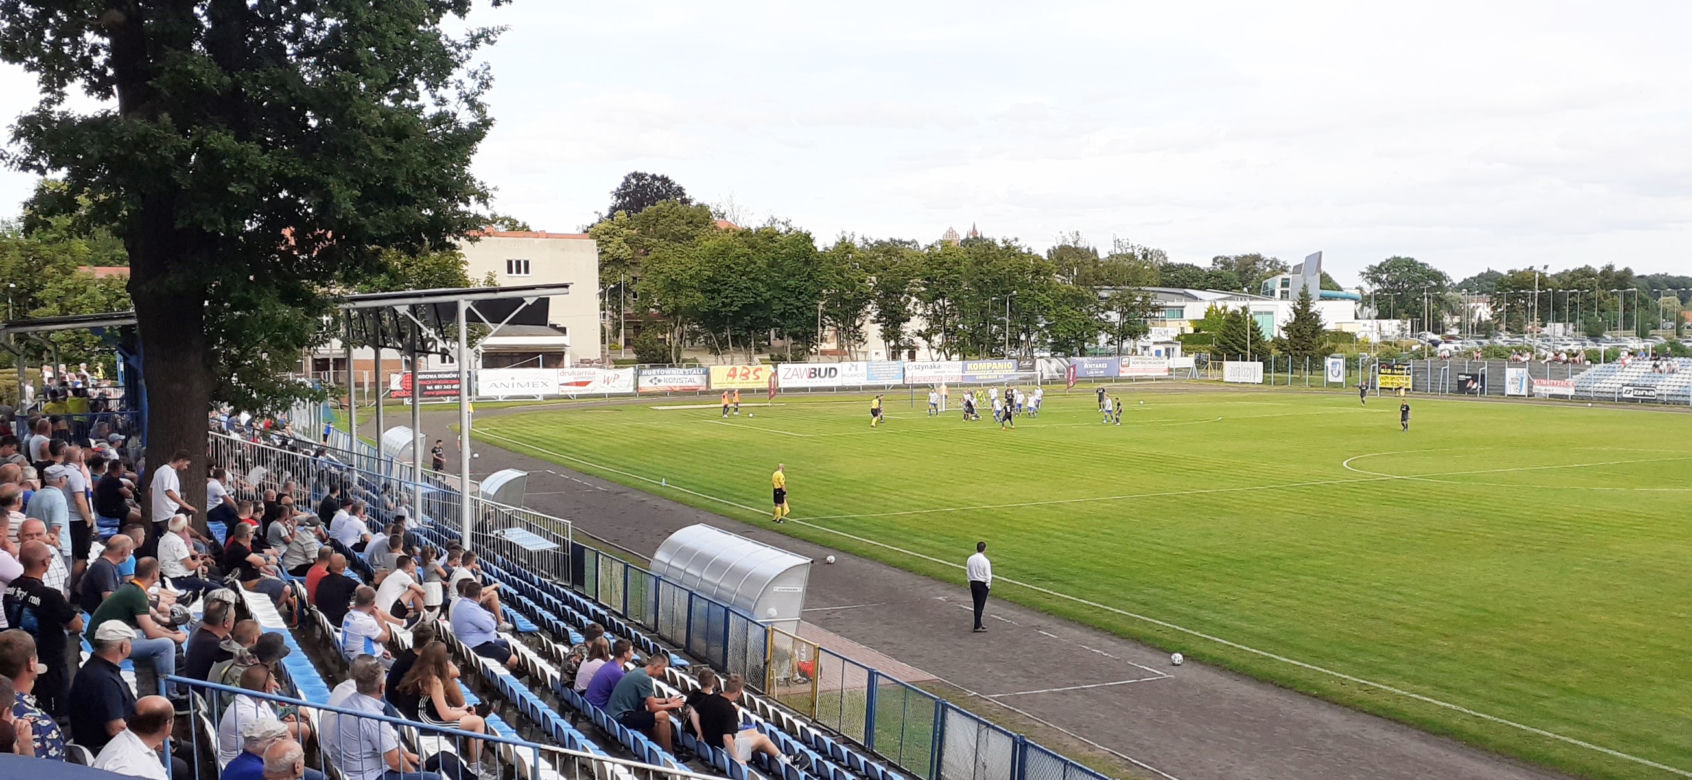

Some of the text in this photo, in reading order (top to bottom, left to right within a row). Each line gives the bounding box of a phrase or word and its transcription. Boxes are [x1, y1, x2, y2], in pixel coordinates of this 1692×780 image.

[967, 361, 1012, 371] KOMPANIO
[559, 369, 596, 377] drukarnia
[726, 366, 763, 380] ABS
[783, 367, 838, 379] ZAWBUD
[663, 376, 697, 384] KONSTAL
